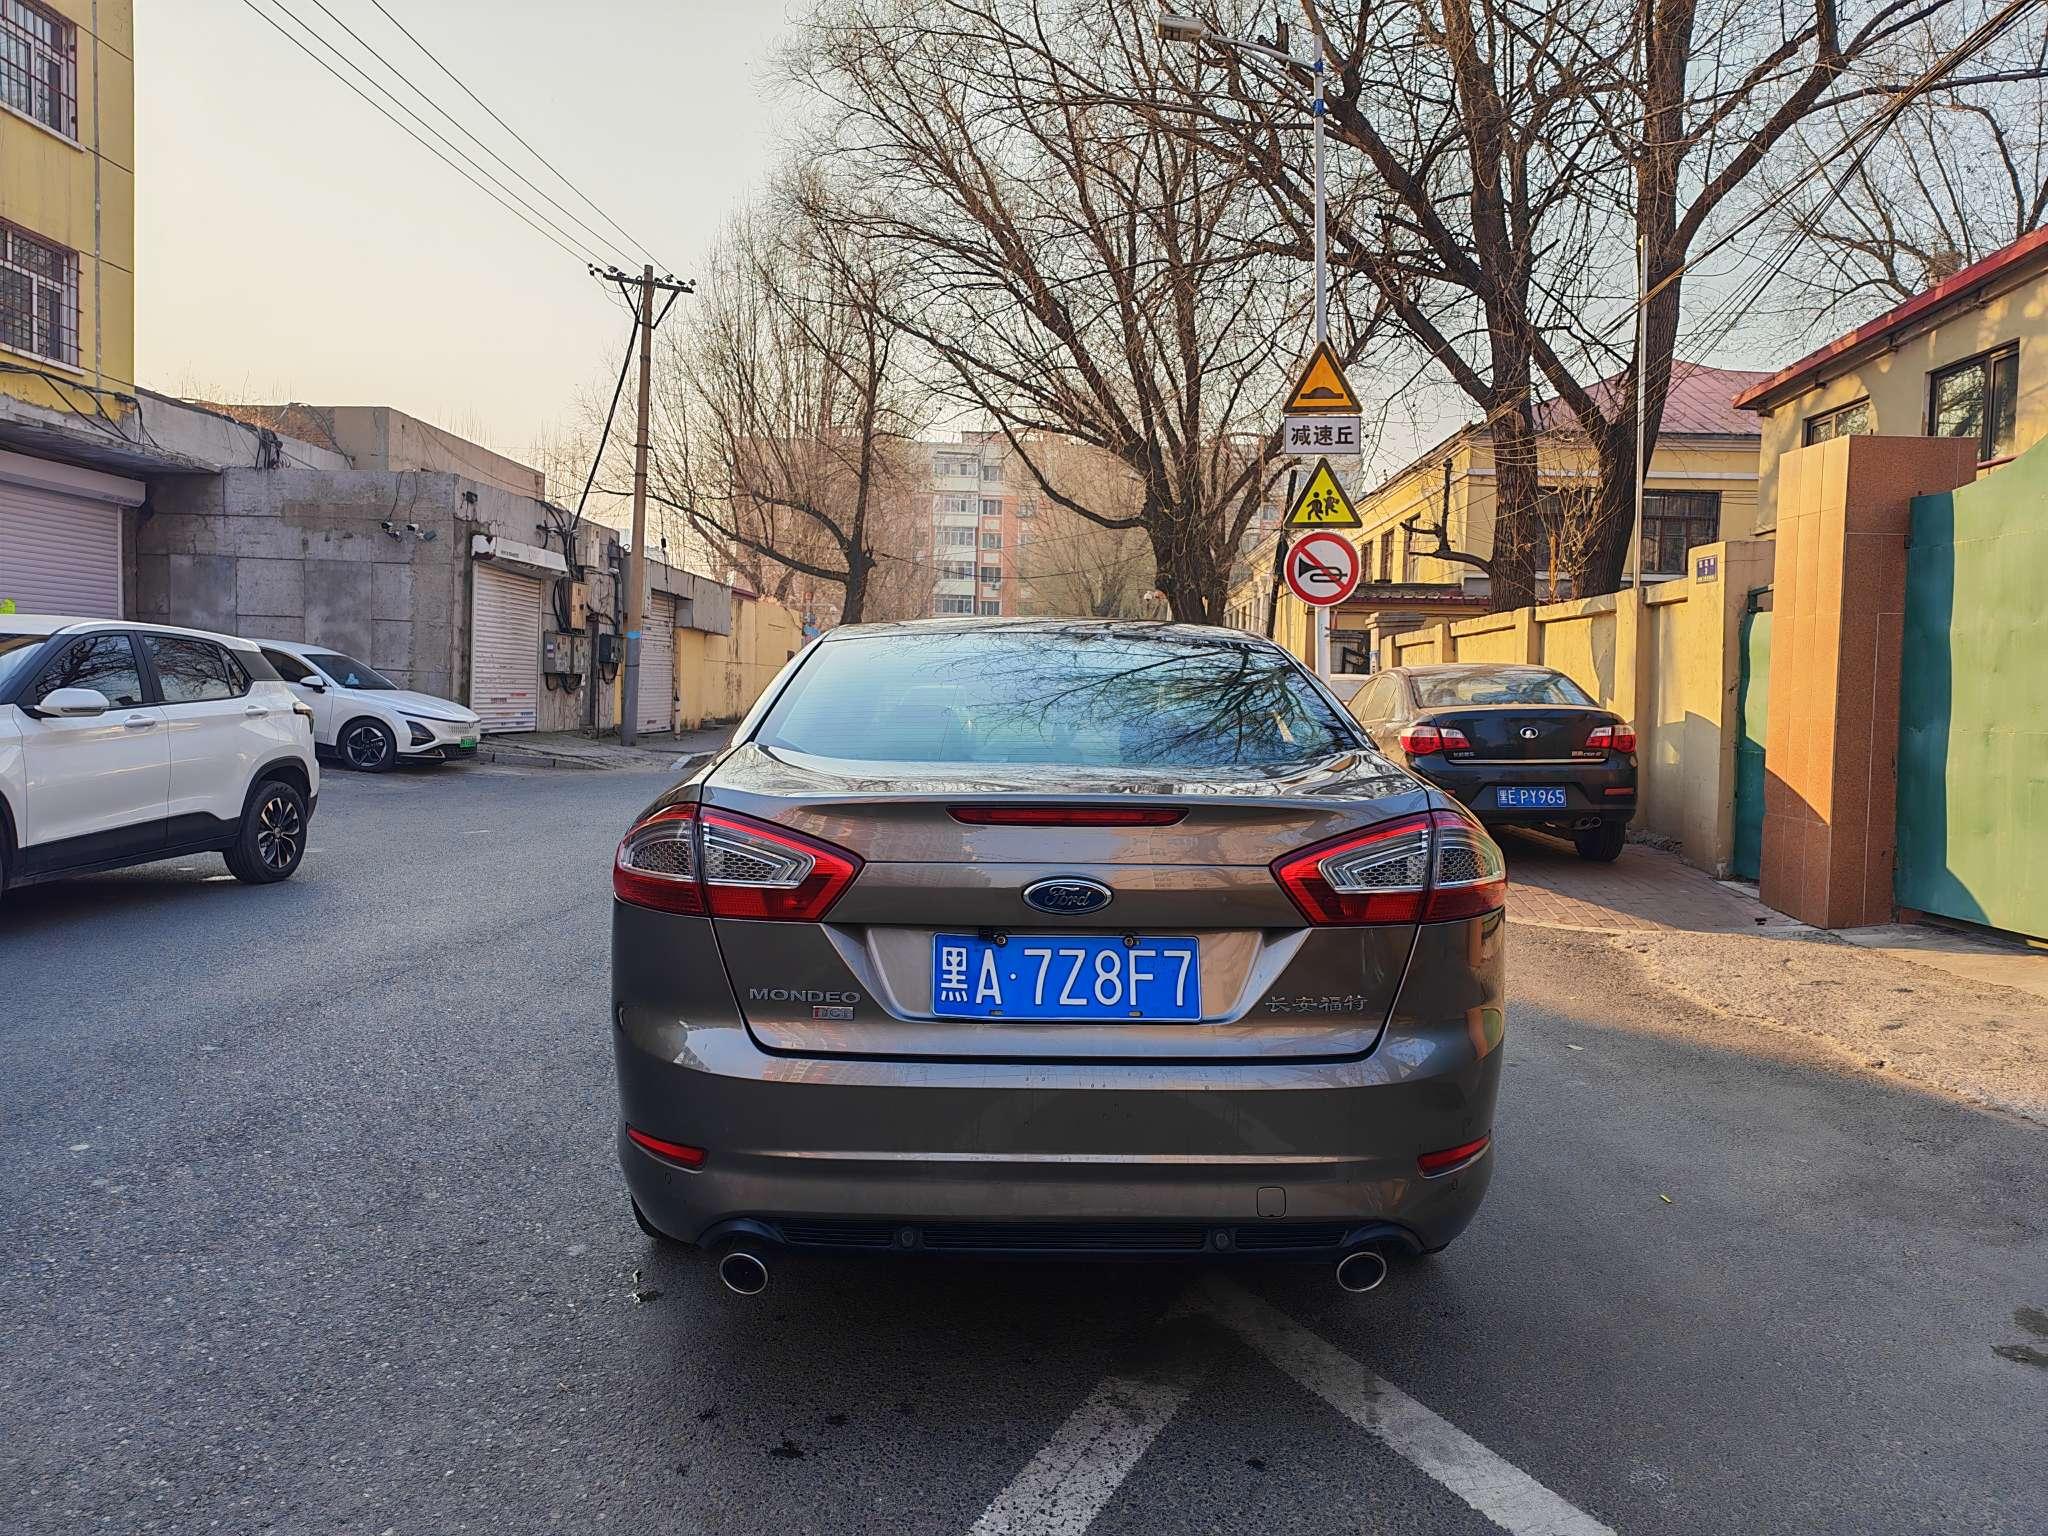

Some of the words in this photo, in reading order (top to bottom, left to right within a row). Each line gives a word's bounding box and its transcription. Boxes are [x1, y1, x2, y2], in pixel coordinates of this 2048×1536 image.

[1290, 424, 1355, 446] 减速丘
[1044, 885, 1092, 907] Ford
[940, 946, 1193, 1007] 黑A·7Z8F7
[749, 987, 862, 1004] MONDEO
[1264, 994, 1369, 1013] 长安福特
